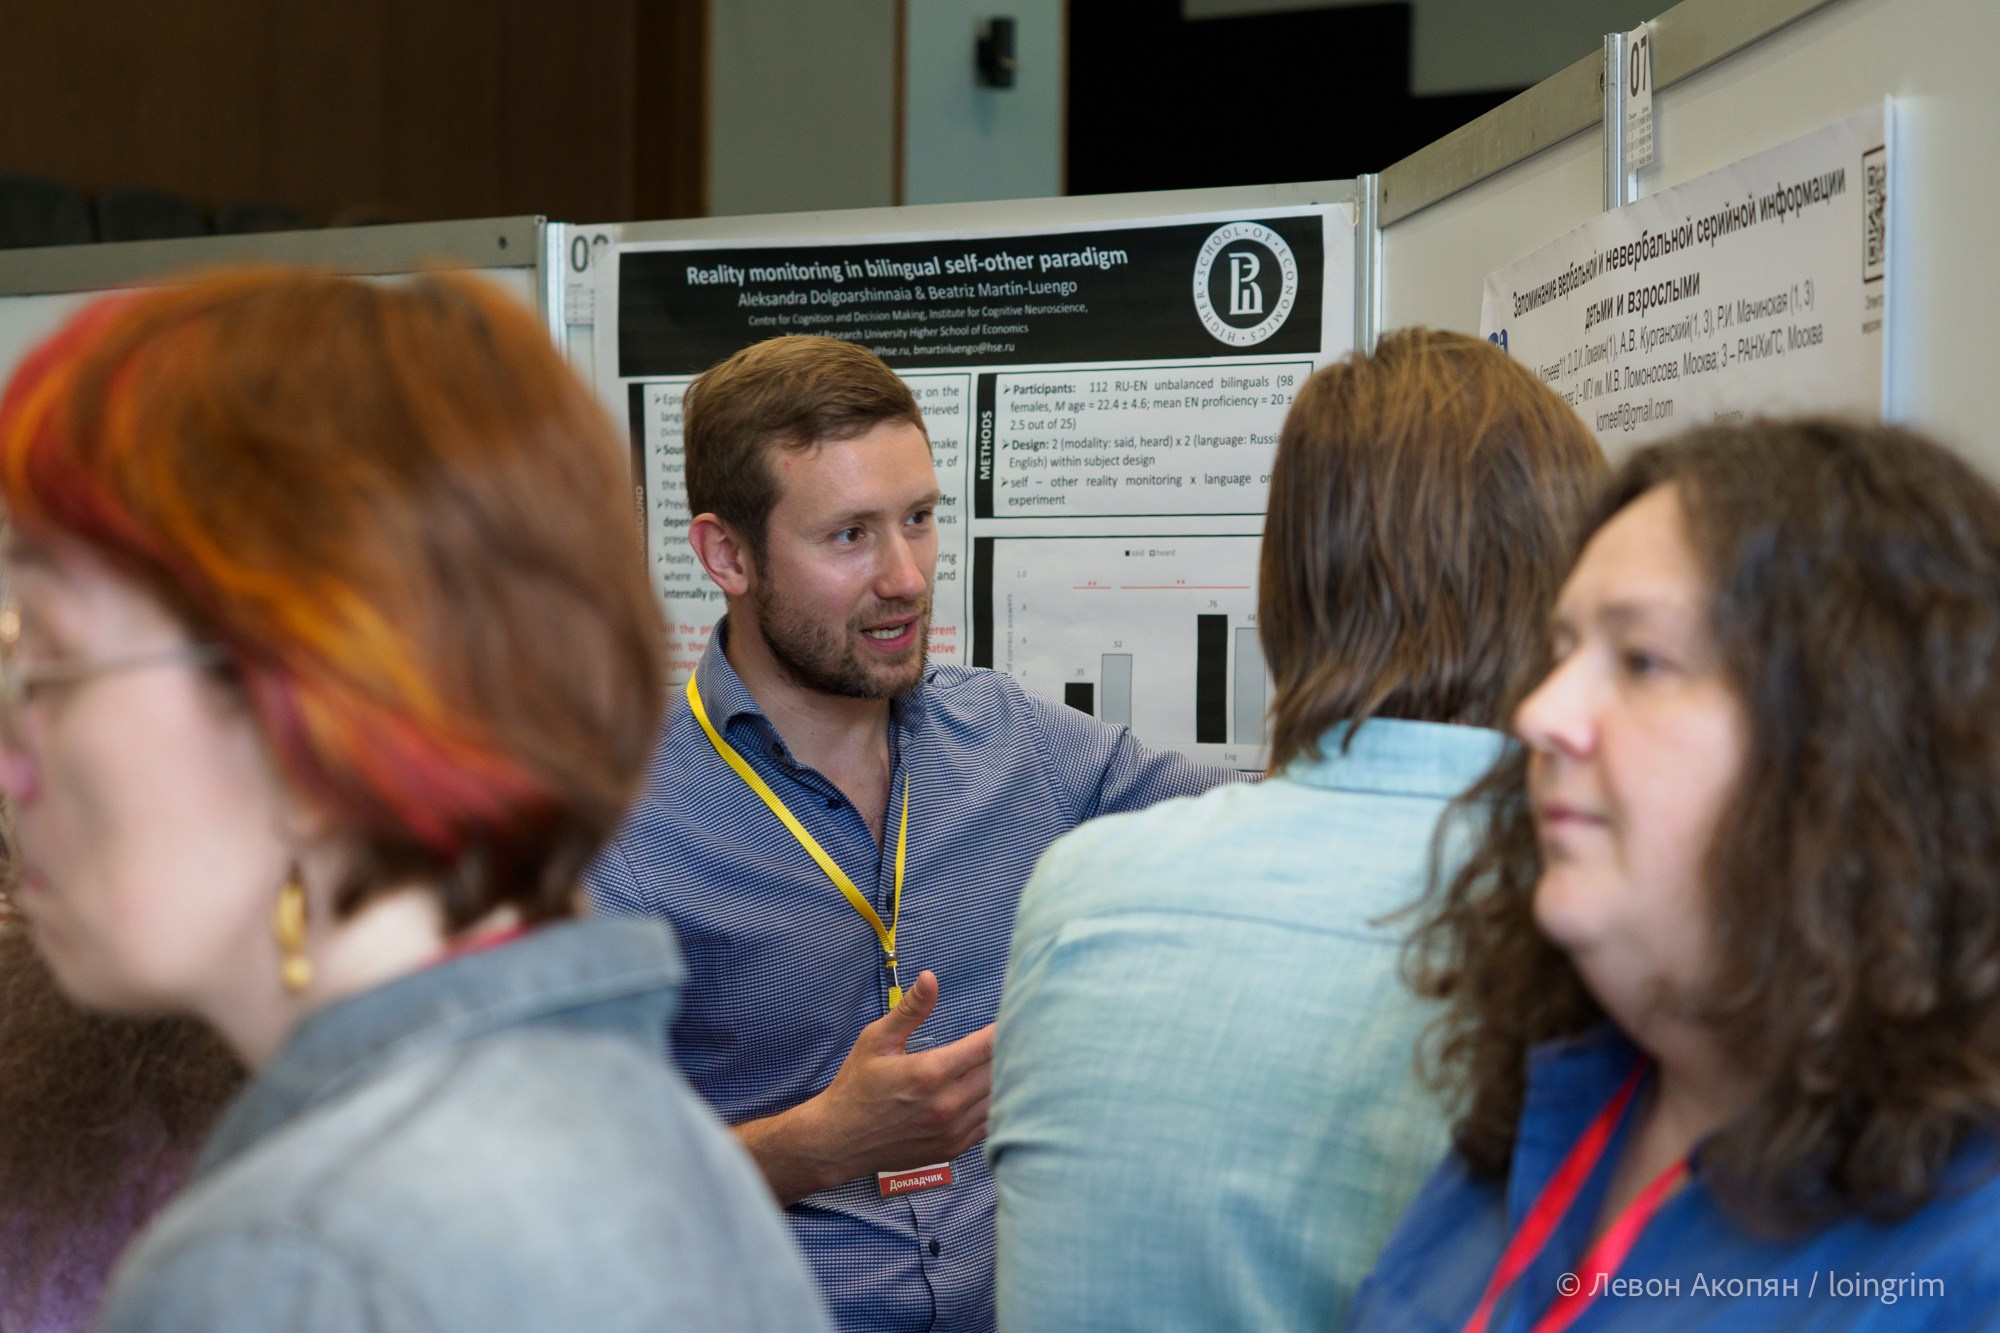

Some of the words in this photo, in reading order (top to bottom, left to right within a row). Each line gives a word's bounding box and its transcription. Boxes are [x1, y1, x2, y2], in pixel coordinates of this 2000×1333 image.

[1630, 34, 1647, 98] 07
[1253, 228, 1272, 242] OF
[1513, 278, 1557, 319] Запоминание
[1558, 249, 1597, 301] вербальной
[1598, 252, 1604, 275] и
[1606, 215, 1693, 272] невербальной
[1696, 195, 1757, 248] серийной
[1760, 167, 1846, 224] информации
[1197, 226, 1240, 277] SCHOOL
[687, 265, 745, 287] Reality
[750, 261, 844, 283] monitoring
[844, 261, 863, 278] in
[865, 257, 941, 281] bilingual
[945, 252, 1034, 274] self-other
[1039, 247, 1128, 273] paradigm
[738, 290, 807, 307] Aleksandra
[810, 286, 912, 307] Dolgoarshinnaia
[914, 285, 927, 299] &
[928, 283, 975, 300] Beatriz
[978, 280, 1078, 298] Martín-Luengo
[1249, 247, 1295, 341] ECONOMICS
[1585, 297, 1613, 335] детьми
[1616, 292, 1624, 316] и
[1627, 272, 1700, 319] взрослыми
[1737, 292, 1788, 325] Мачинская
[748, 315, 776, 326] Centre
[777, 313, 791, 325] for
[792, 313, 834, 327] Cognition
[835, 312, 852, 323] and
[853, 311, 891, 322] Decision
[892, 309, 927, 322] Making,
[929, 308, 966, 319] Institute
[967, 306, 980, 318] for
[981, 305, 1023, 319] Cognitive
[1024, 302, 1088, 316] Neuroscience,
[1196, 290, 1236, 342] HIGHER
[864, 327, 908, 341] University
[909, 326, 938, 340] Higher
[940, 325, 969, 336] School
[970, 323, 981, 335] of
[982, 322, 1029, 335] Economics
[1721, 342, 1728, 368] 3
[925, 388, 938, 397] on
[943, 386, 959, 397] the
[1013, 384, 1076, 397] Participants:
[1090, 382, 1108, 393] 112
[1115, 380, 1148, 392] RU-EN
[1154, 378, 1214, 391] unbalanced
[1220, 376, 1270, 390] bilinguals
[1276, 374, 1294, 388] (98
[1010, 401, 1052, 413] females,
[1054, 401, 1066, 411] M
[1068, 402, 1086, 413] age
[1097, 399, 1119, 411] 22.4
[1131, 399, 1150, 411] 4.6;
[1153, 399, 1182, 409] mean
[1185, 397, 1199, 408] EN
[1202, 395, 1259, 410] proficiency
[1271, 394, 1284, 406] 20
[1010, 419, 1025, 430] 2.5
[1028, 418, 1045, 430] out
[1047, 418, 1058, 430] of
[1060, 418, 1077, 432] 25)
[980, 410, 993, 480] METHODS
[1012, 439, 1049, 452] Design:
[1051, 439, 1059, 449] 2
[1061, 437, 1112, 451] (modality:
[1114, 436, 1137, 449] said,
[1140, 435, 1173, 449] heard)
[1175, 438, 1182, 447] x
[1184, 436, 1191, 447] 2
[1194, 434, 1247, 449] (language:
[947, 457, 958, 468] of
[1010, 457, 1047, 471] English)
[1051, 456, 1082, 468] within
[1085, 455, 1120, 470] subject
[1123, 454, 1155, 468] design
[1010, 476, 1028, 488] self
[1051, 476, 1078, 488] other
[1086, 475, 1118, 489] reality
[1126, 474, 1182, 488] monitoring
[1190, 476, 1196, 485] x
[1204, 473, 1251, 488] language
[1008, 494, 1066, 508] experiment
[938, 515, 957, 524] was
[937, 570, 956, 581] and
[664, 588, 707, 602] internally
[890, 1173, 943, 1192] Докладчик
